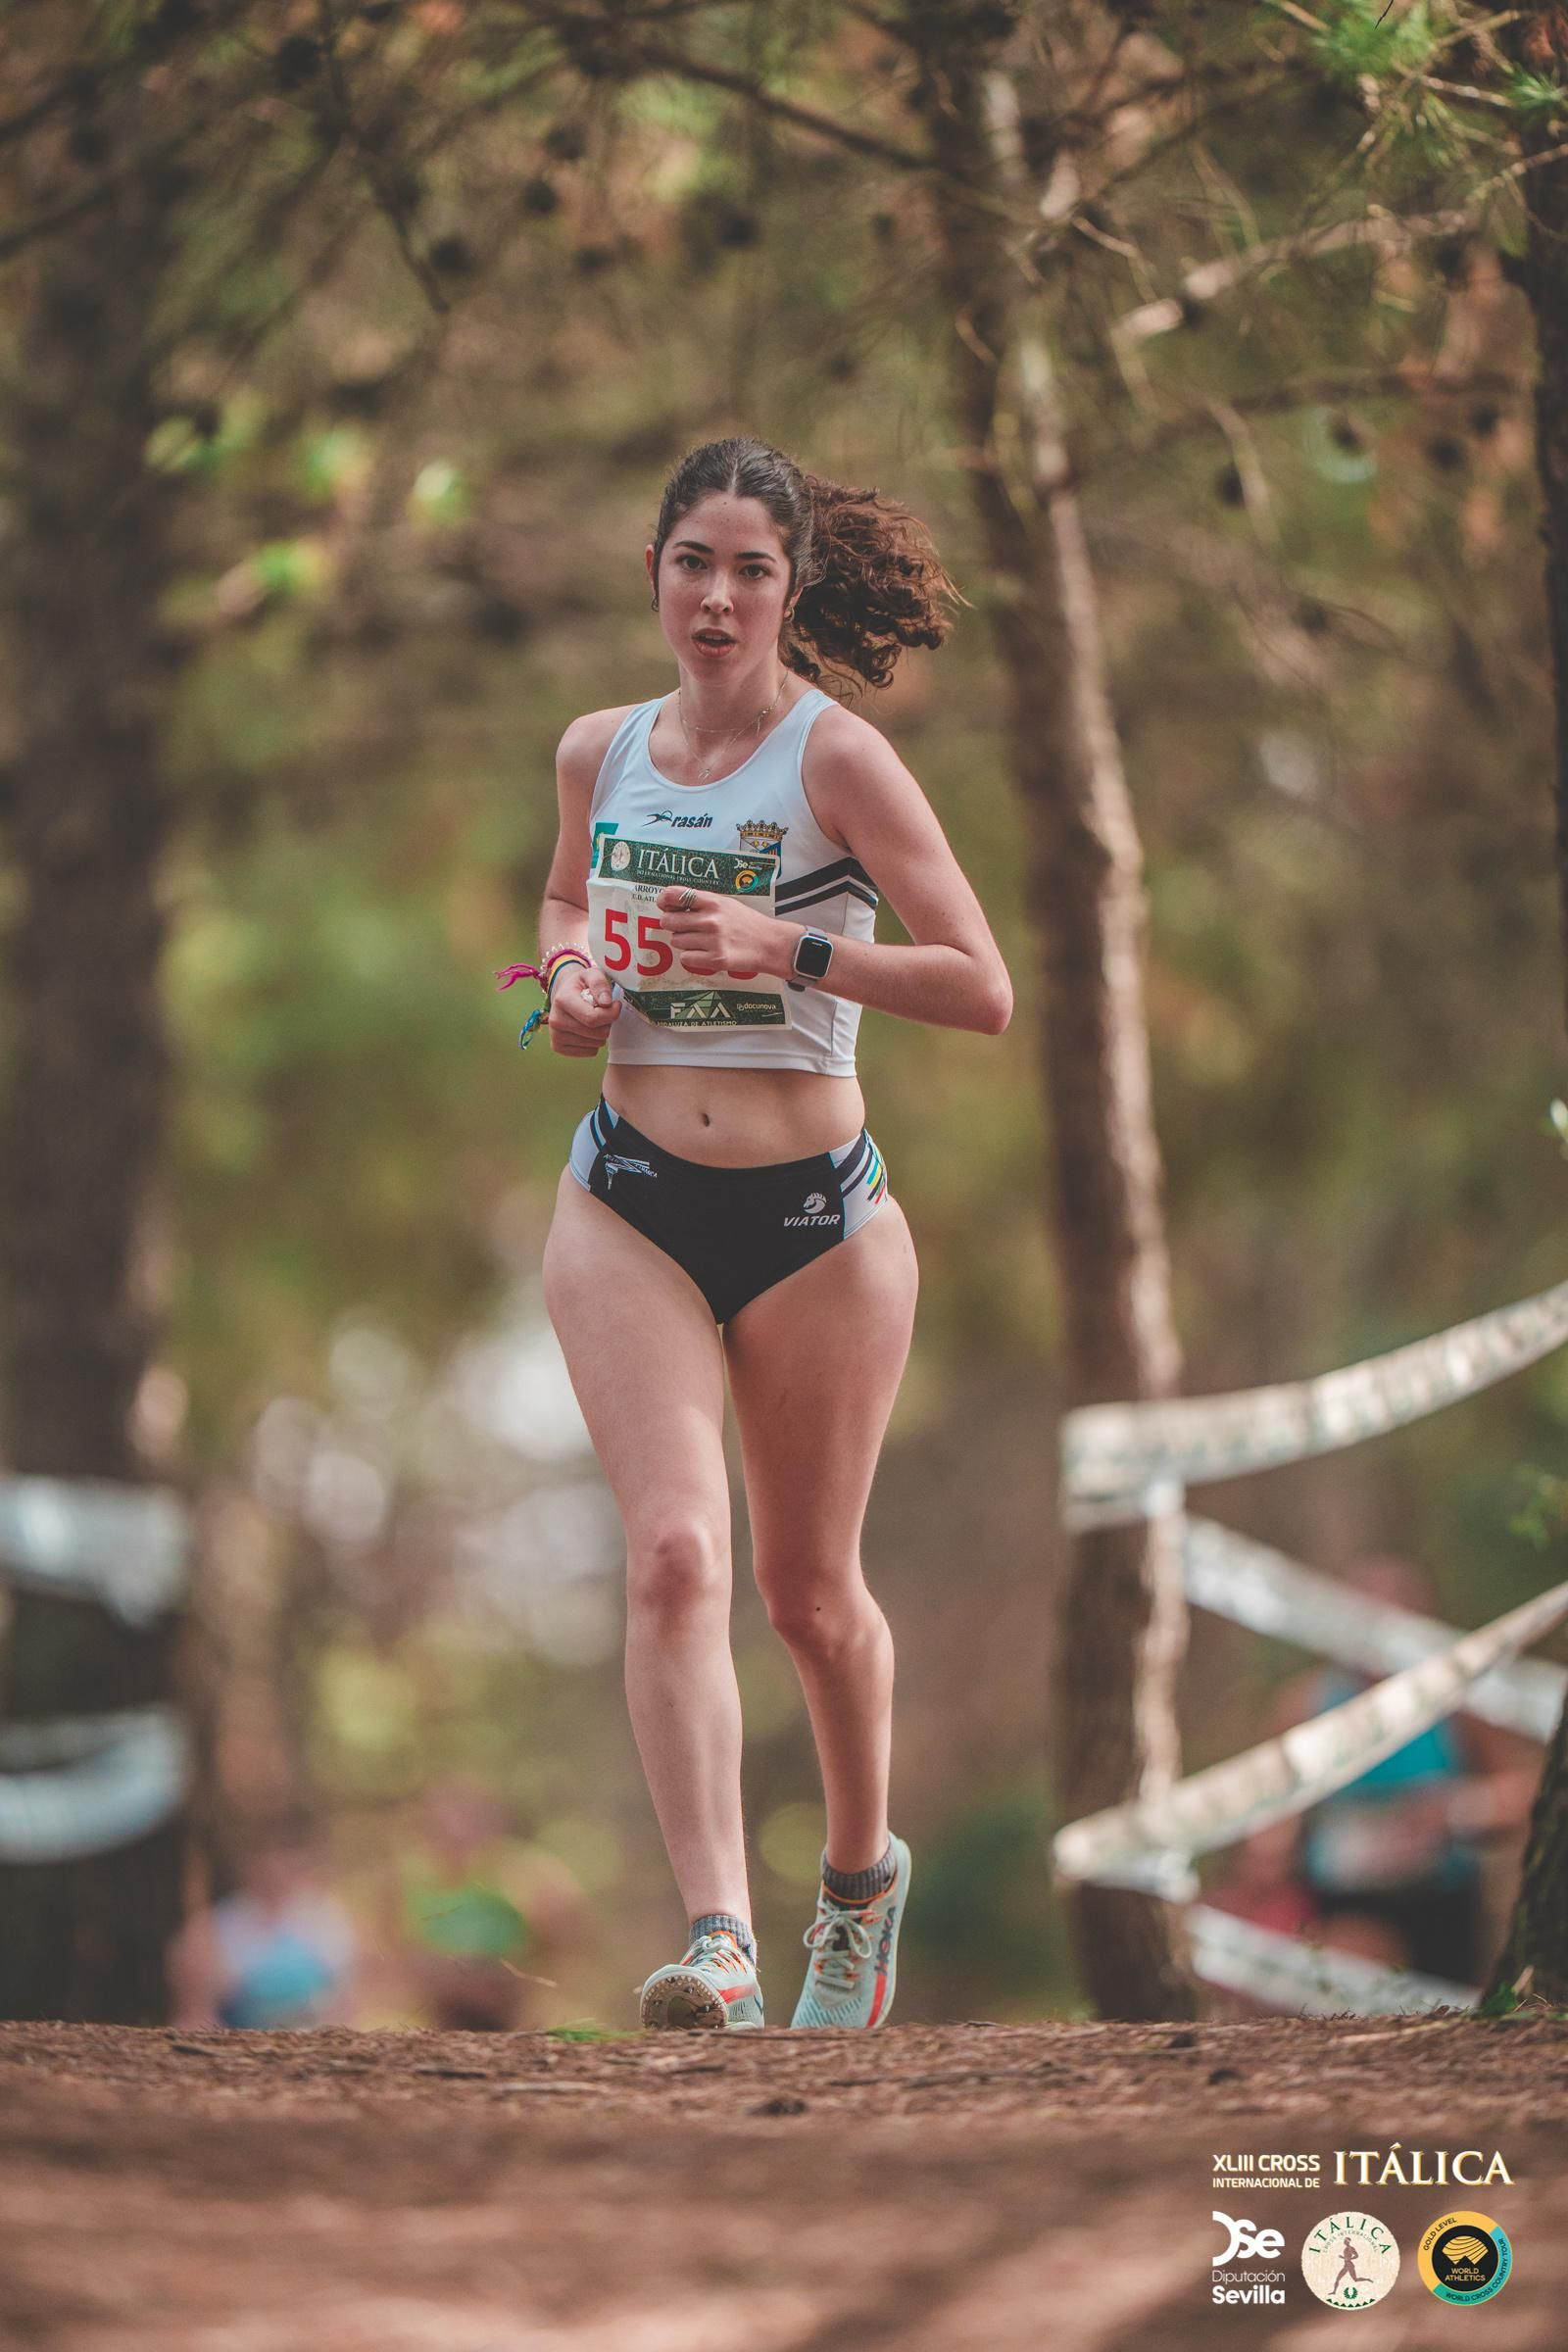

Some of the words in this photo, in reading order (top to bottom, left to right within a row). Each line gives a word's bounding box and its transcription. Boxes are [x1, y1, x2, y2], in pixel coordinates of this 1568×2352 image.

[670, 812, 713, 828] rasán
[637, 848, 720, 880] ITÁLICA
[604, 908, 759, 980] 55
[783, 1214, 841, 1227] VIATOR
